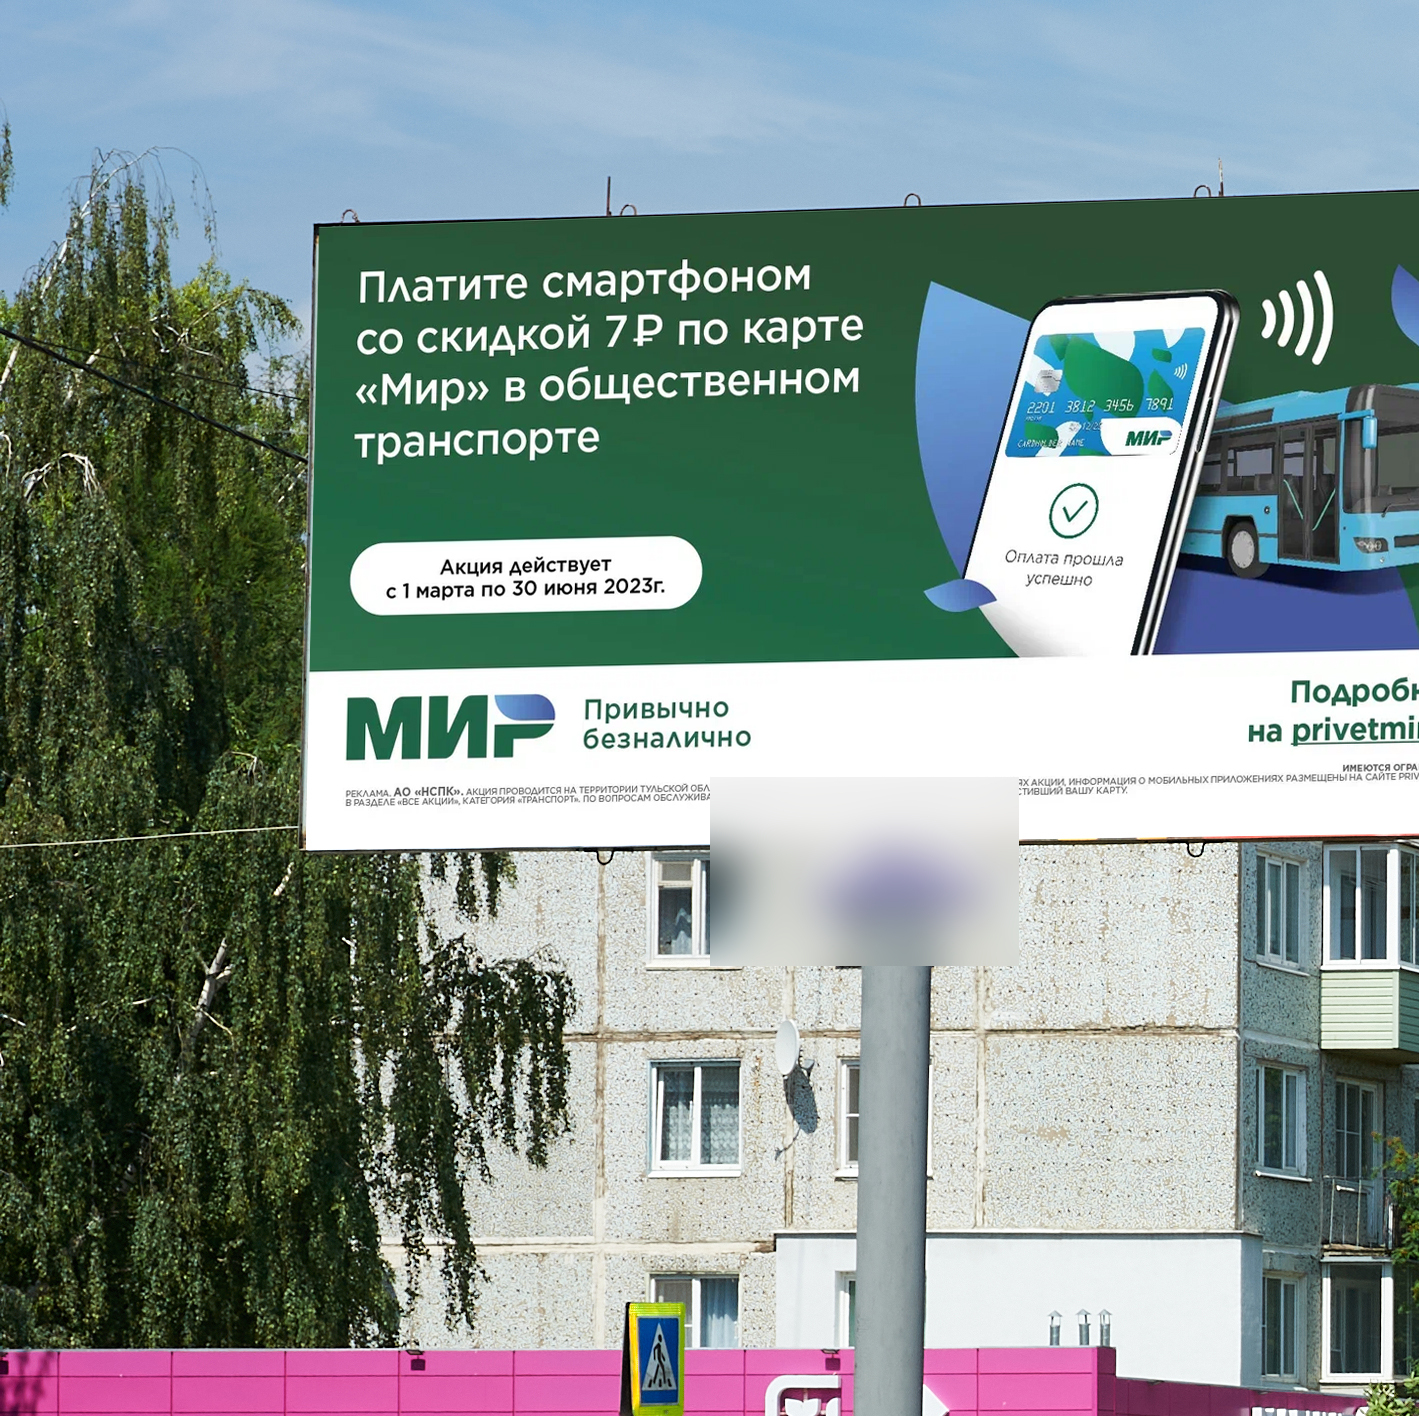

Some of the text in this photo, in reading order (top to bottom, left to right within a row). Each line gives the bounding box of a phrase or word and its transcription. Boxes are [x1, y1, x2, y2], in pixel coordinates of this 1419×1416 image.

[359, 258, 811, 304] Платите смартфоном
[356, 328, 404, 355] со
[416, 314, 590, 357] скидкой
[678, 319, 729, 346] по
[743, 314, 864, 350] карте
[355, 366, 860, 412] «Мир» в общественном
[1026, 397, 1174, 414] 2201 3812 3456 7891
[354, 426, 600, 465] транспорте
[1124, 430, 1173, 447] МИР
[440, 556, 612, 578] Акция действует
[1004, 548, 1124, 568] Оплата прошла
[386, 577, 666, 602] с 1 марта по 30 июня 2023г.
[1025, 571, 1093, 587] успешно
[583, 698, 730, 724] Привычно
[346, 693, 557, 760] МИР
[1248, 722, 1283, 743] на
[582, 727, 752, 750] безналично
[1342, 763, 1391, 772] ИМЕЮТСЯ
[1031, 777, 1067, 787] АКЦИИ,
[1069, 776, 1137, 787] ИНФОРМАЦИЯ
[1138, 776, 1146, 785] О
[1148, 775, 1209, 785] МОБИЛЬНЫХ
[1211, 774, 1284, 784] ПРИЛОЖЕНИЯХ
[1286, 773, 1348, 783] РАЗМЕЩЕНЫ
[1349, 773, 1363, 782] НА
[1365, 771, 1397, 781] САЙТЕ
[345, 789, 392, 798] РЕКЛАМА.
[393, 786, 411, 797] АО
[414, 786, 464, 797] «НСПК».
[466, 787, 498, 797] АКЦИЯ
[499, 786, 562, 796] ПРОВОДИТСЯ
[563, 786, 577, 794] НА
[579, 785, 639, 794] ТЕРРИТОРИИ
[640, 783, 689, 793] ТУЛЬСКОЙ
[345, 798, 352, 807] В
[353, 798, 396, 807] РАЗДЕЛЕ
[397, 797, 420, 806] «ВСЕ
[462, 796, 515, 805] КАТЕГОРИЯ
[517, 794, 581, 805] «ТРАНСПОРТ».
[583, 794, 597, 803] ПО
[598, 793, 651, 803] ВОПРОСАМ
[1066, 786, 1094, 795] ВАШУ
[1095, 786, 1128, 795] КАРТУ.
